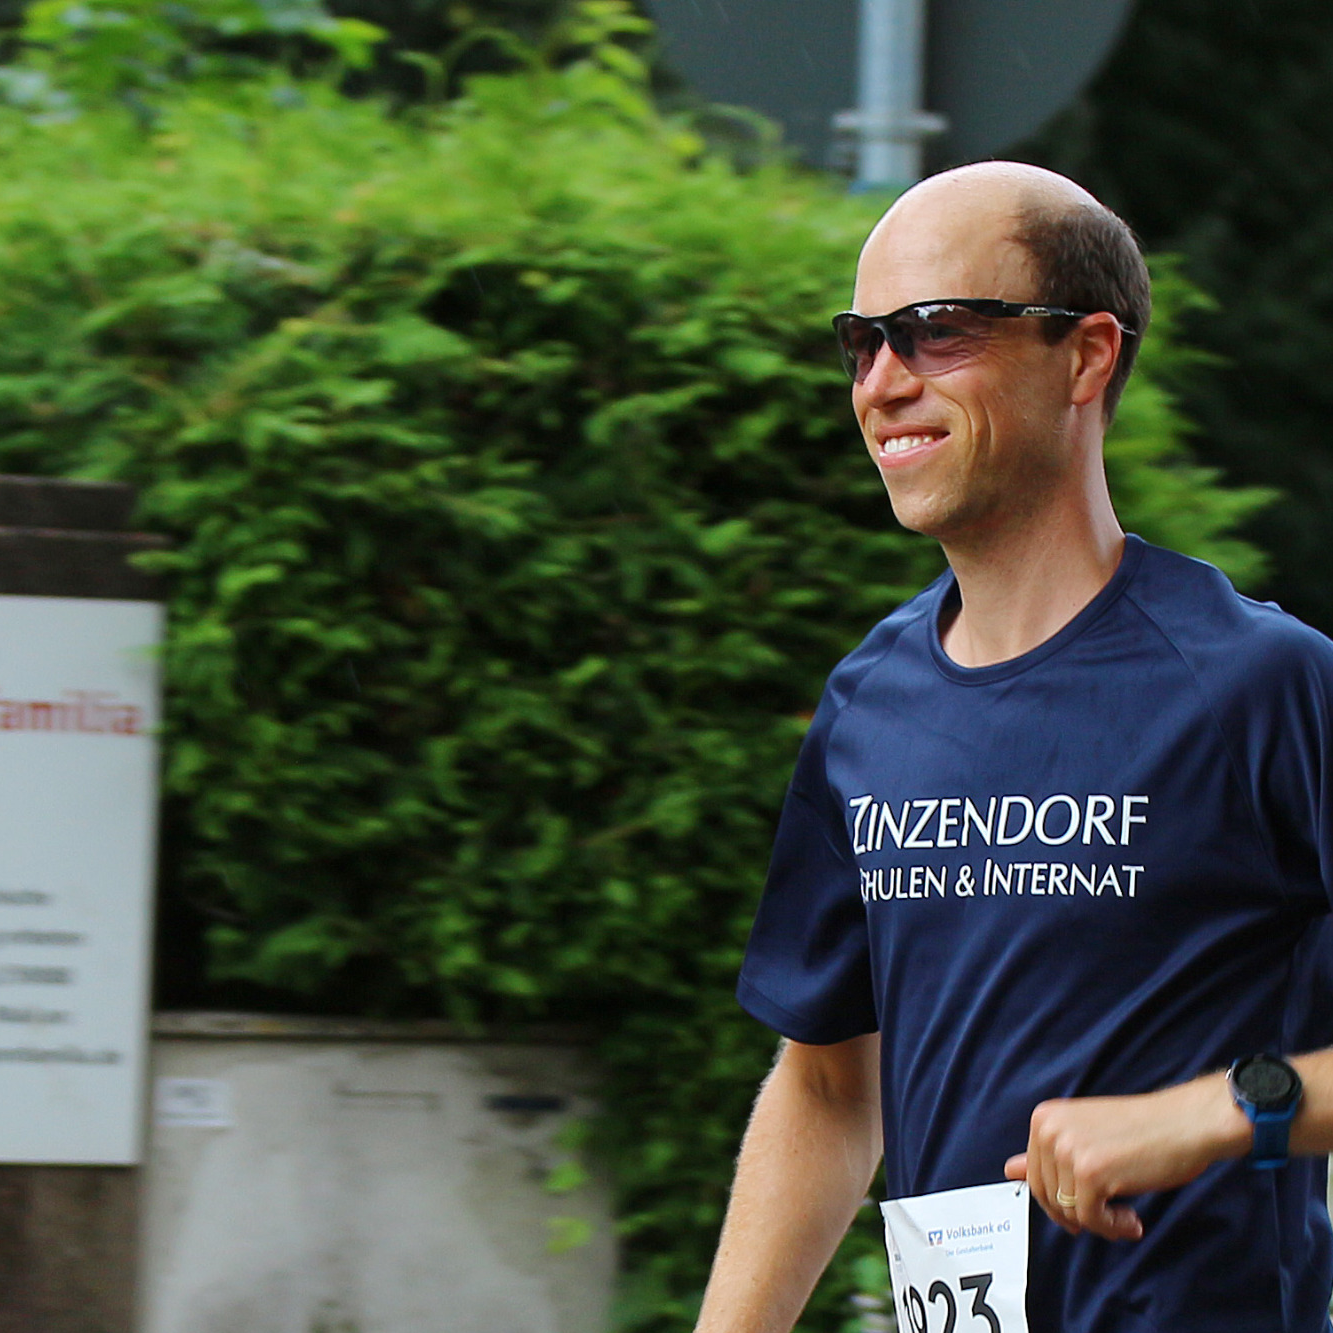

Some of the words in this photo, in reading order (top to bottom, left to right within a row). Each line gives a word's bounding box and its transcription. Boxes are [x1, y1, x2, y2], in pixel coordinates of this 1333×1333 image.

[848, 794, 1149, 855] ZINZENDORF
[955, 865, 976, 897] &
[983, 858, 1146, 899] INTERNAT
[946, 1221, 994, 1240] Volksbank
[997, 1219, 1011, 1233] eG
